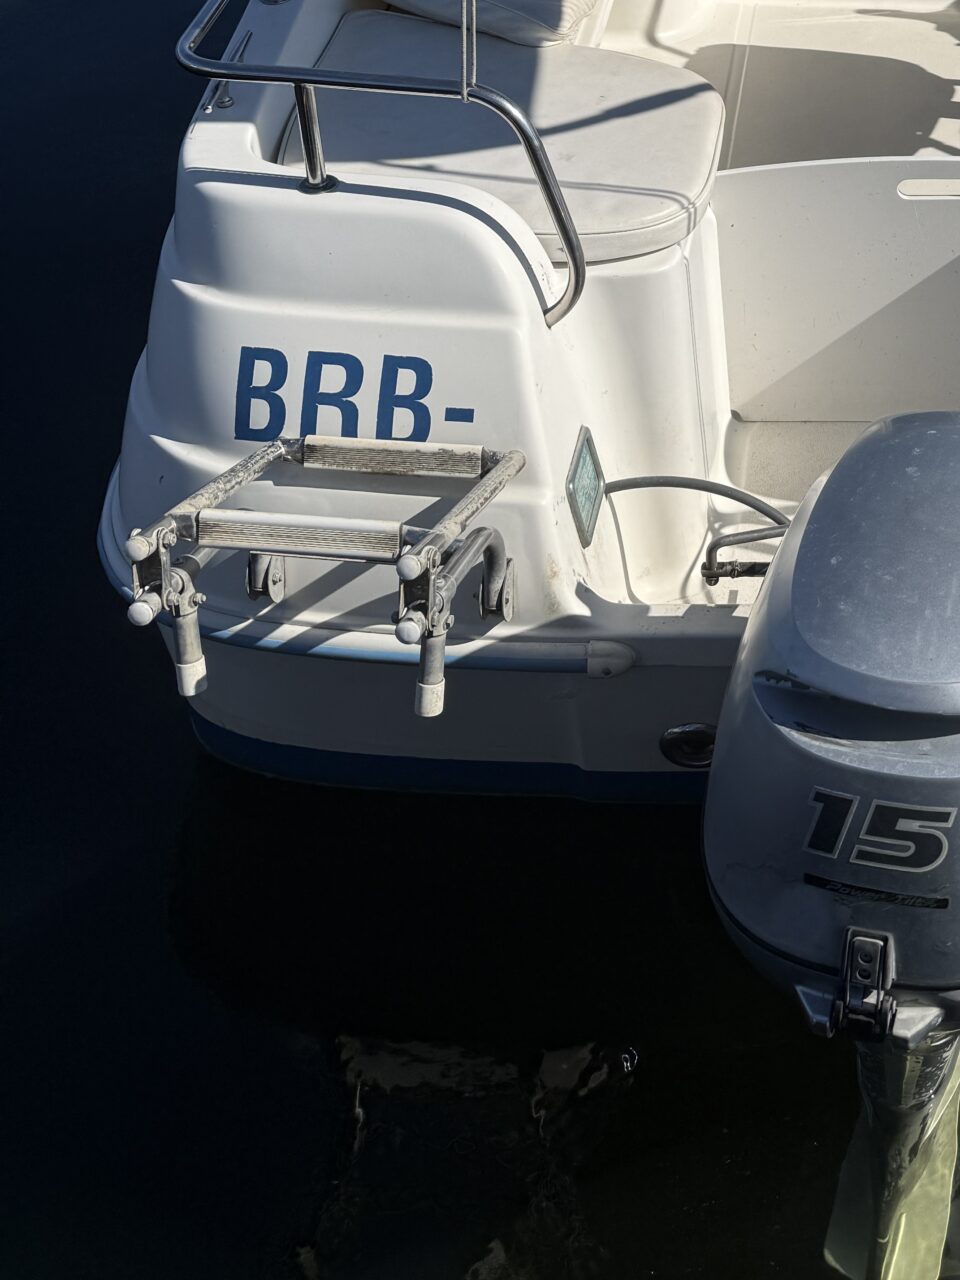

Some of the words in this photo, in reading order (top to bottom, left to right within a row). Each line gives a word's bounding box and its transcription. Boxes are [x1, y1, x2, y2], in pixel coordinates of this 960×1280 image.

[234, 346, 475, 442] BRB-
[803, 785, 958, 873] 15
[825, 880, 886, 901] Power
